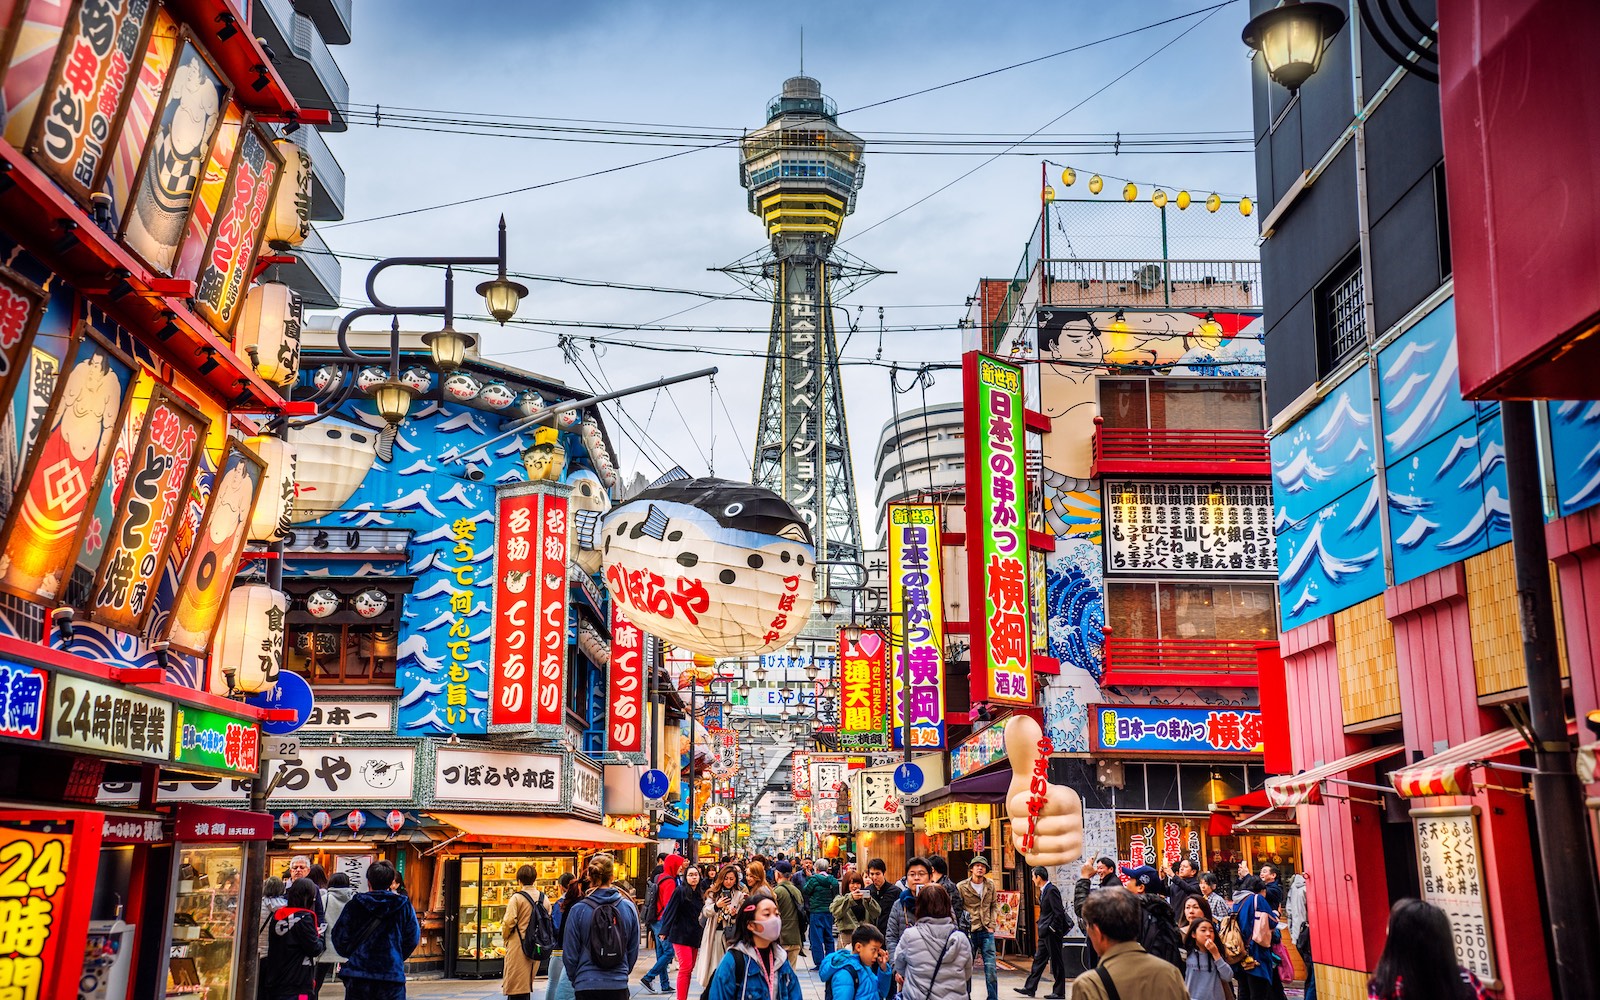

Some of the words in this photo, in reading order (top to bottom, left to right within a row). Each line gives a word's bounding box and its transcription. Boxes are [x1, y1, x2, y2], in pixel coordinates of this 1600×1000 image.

[981, 361, 1018, 394] 新世界
[151, 405, 181, 451] 名物
[989, 388, 1018, 553] 日本一の串かつ
[130, 425, 199, 617] 大阪下町の味
[507, 507, 531, 563] 名物
[544, 508, 565, 562] 名物
[893, 508, 936, 525] 新世界
[1112, 526, 1126, 569] もち
[1127, 526, 1141, 569] うずら玉子
[1140, 526, 1156, 569] 紅しょうが
[1155, 526, 1169, 569] にんにく
[1169, 526, 1184, 569] 玉ねぎ
[1184, 526, 1198, 569] 山芋
[1199, 526, 1214, 569] しし唐
[1213, 526, 1228, 569] れんこん
[1227, 526, 1242, 569] 銀杏
[1243, 526, 1257, 569] 白ねぎ
[1257, 526, 1269, 569] さつま芋
[606, 562, 710, 626] づぼらや
[901, 526, 931, 644] 日本一の串かつ
[446, 517, 477, 725] 安うて何んでも旨い
[762, 573, 802, 646] づぼらや
[987, 554, 1028, 669] 横綱
[501, 600, 528, 713] てっちり
[540, 601, 563, 713] てっちり
[844, 659, 871, 731] 通天閣
[872, 659, 883, 731] TSUTENKAKU
[896, 645, 940, 726] 横綱
[995, 671, 1027, 697] 酒処
[57, 686, 165, 754] 24時間営業
[306, 705, 378, 726] 日本一
[901, 726, 940, 747] 酒処
[1103, 711, 1117, 747] 新世界
[1118, 719, 1206, 741] 日本一の串かつ
[1207, 712, 1263, 749] 横綱
[182, 724, 225, 755] 日本一の串かつ
[224, 722, 259, 772] 横綱
[858, 733, 883, 745] 横綱
[442, 764, 556, 790] づぼらや本店
[195, 822, 227, 836] 横綱
[1144, 827, 1156, 865] ソースの
[1440, 821, 1457, 895] ふぐ天ぷら
[1451, 822, 1468, 895] ふぐ天丼
